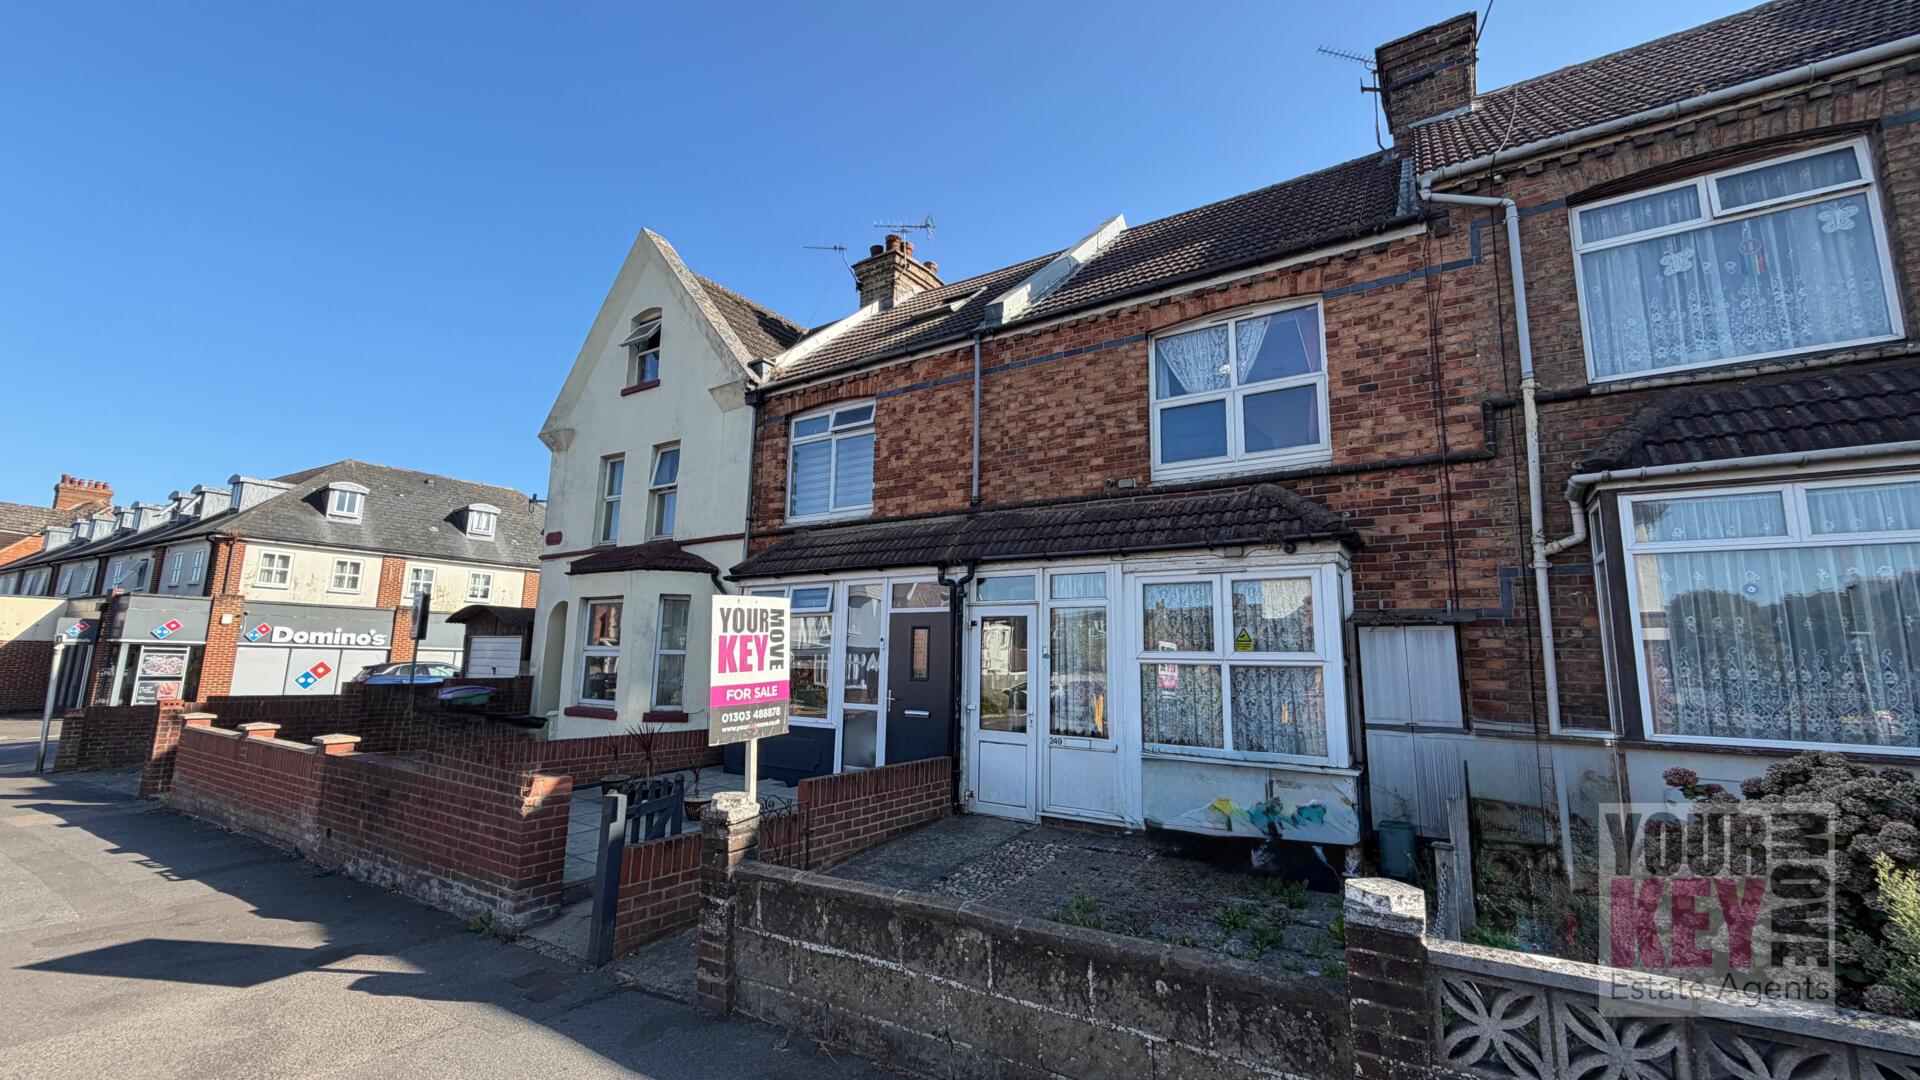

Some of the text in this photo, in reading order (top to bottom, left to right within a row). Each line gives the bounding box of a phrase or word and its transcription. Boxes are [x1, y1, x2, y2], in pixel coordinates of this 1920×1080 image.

[719, 607, 769, 633] YOUR
[271, 626, 387, 645] Domino's
[769, 608, 785, 671] MOVE
[718, 634, 769, 673] KEY
[726, 685, 778, 701] FOR SALE
[721, 706, 781, 723] 01303 488878
[1049, 737, 1063, 745] 249
